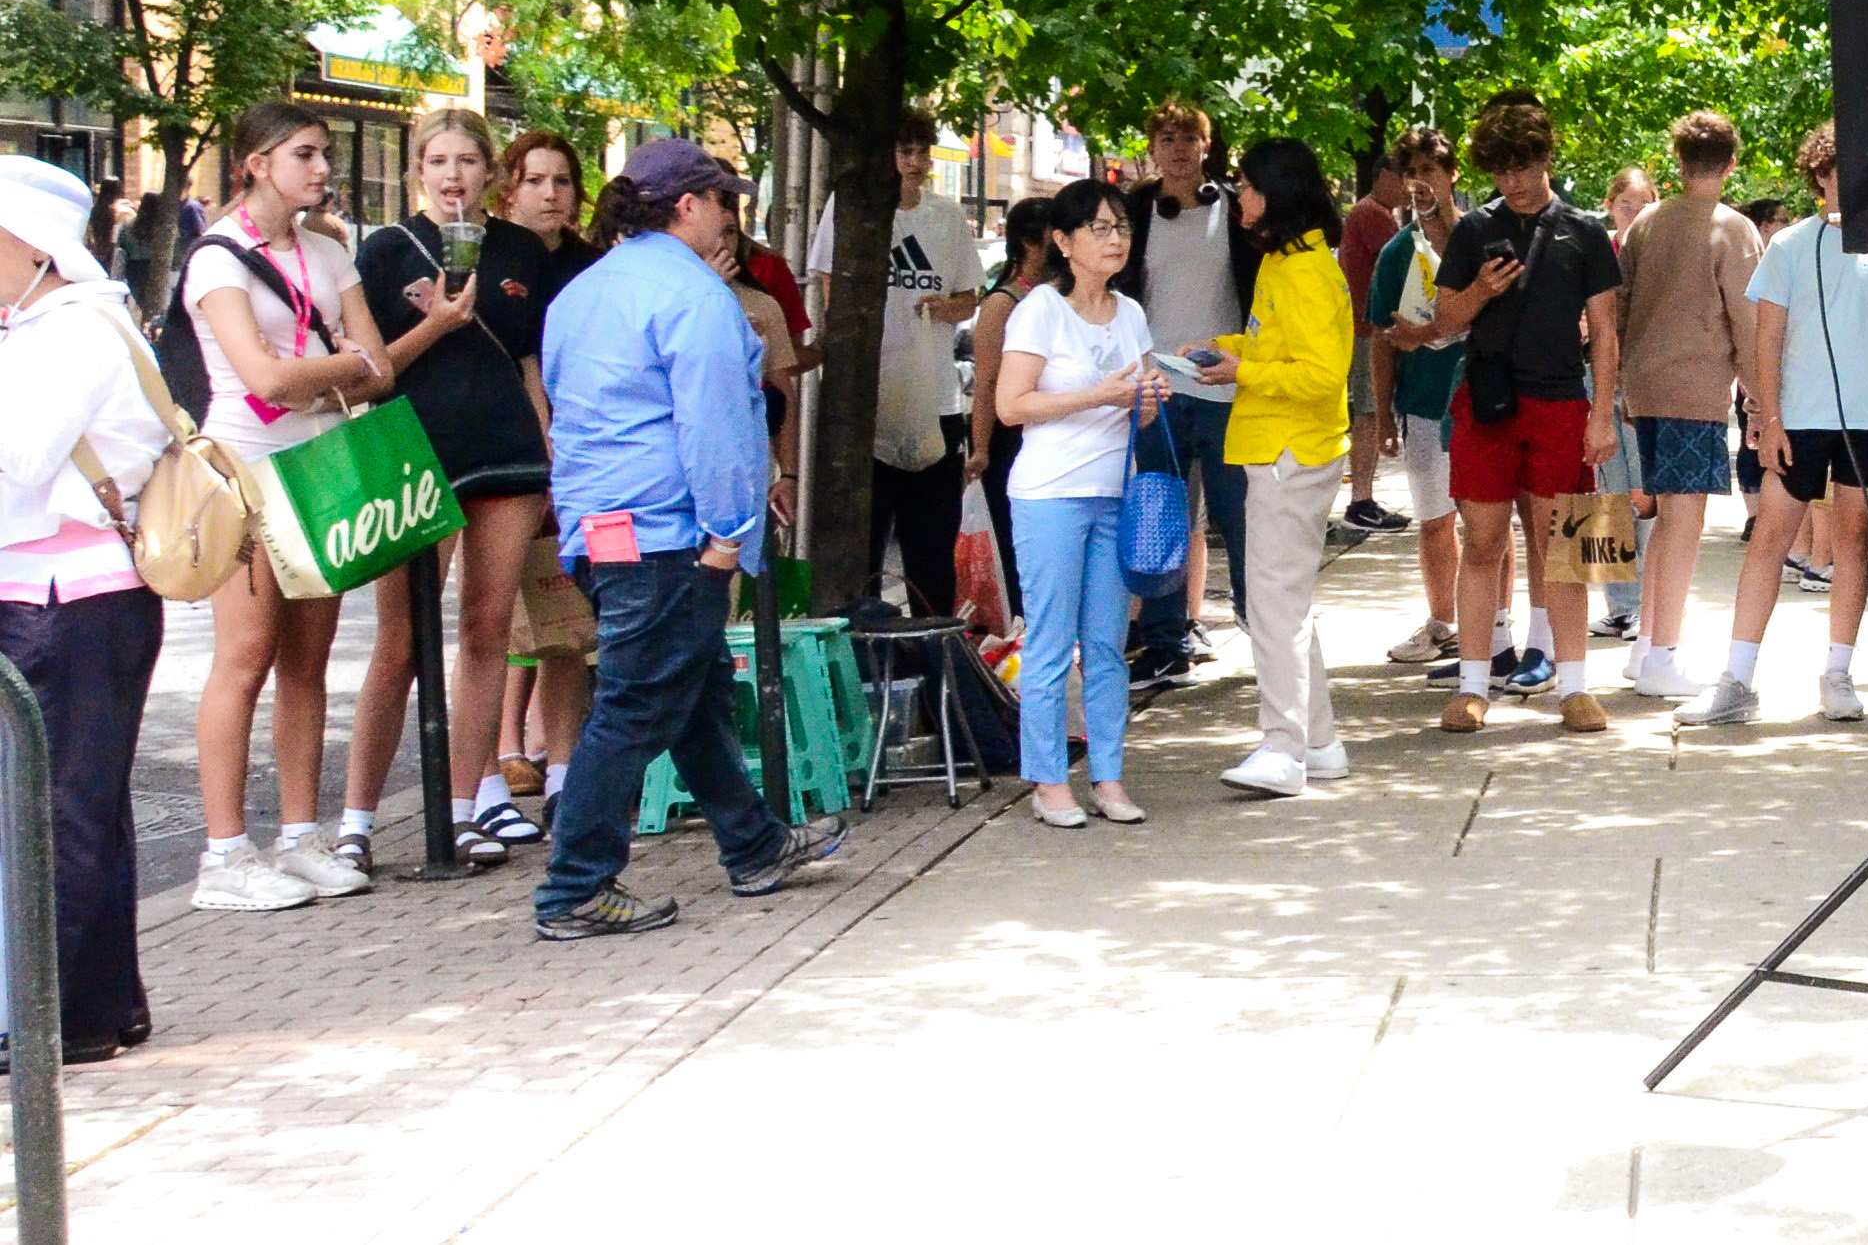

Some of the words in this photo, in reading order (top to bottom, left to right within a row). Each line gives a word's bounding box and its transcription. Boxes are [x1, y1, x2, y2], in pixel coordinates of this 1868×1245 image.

[887, 266, 943, 292] didas
[326, 462, 441, 568] aerie
[1581, 537, 1618, 564] NIKE
